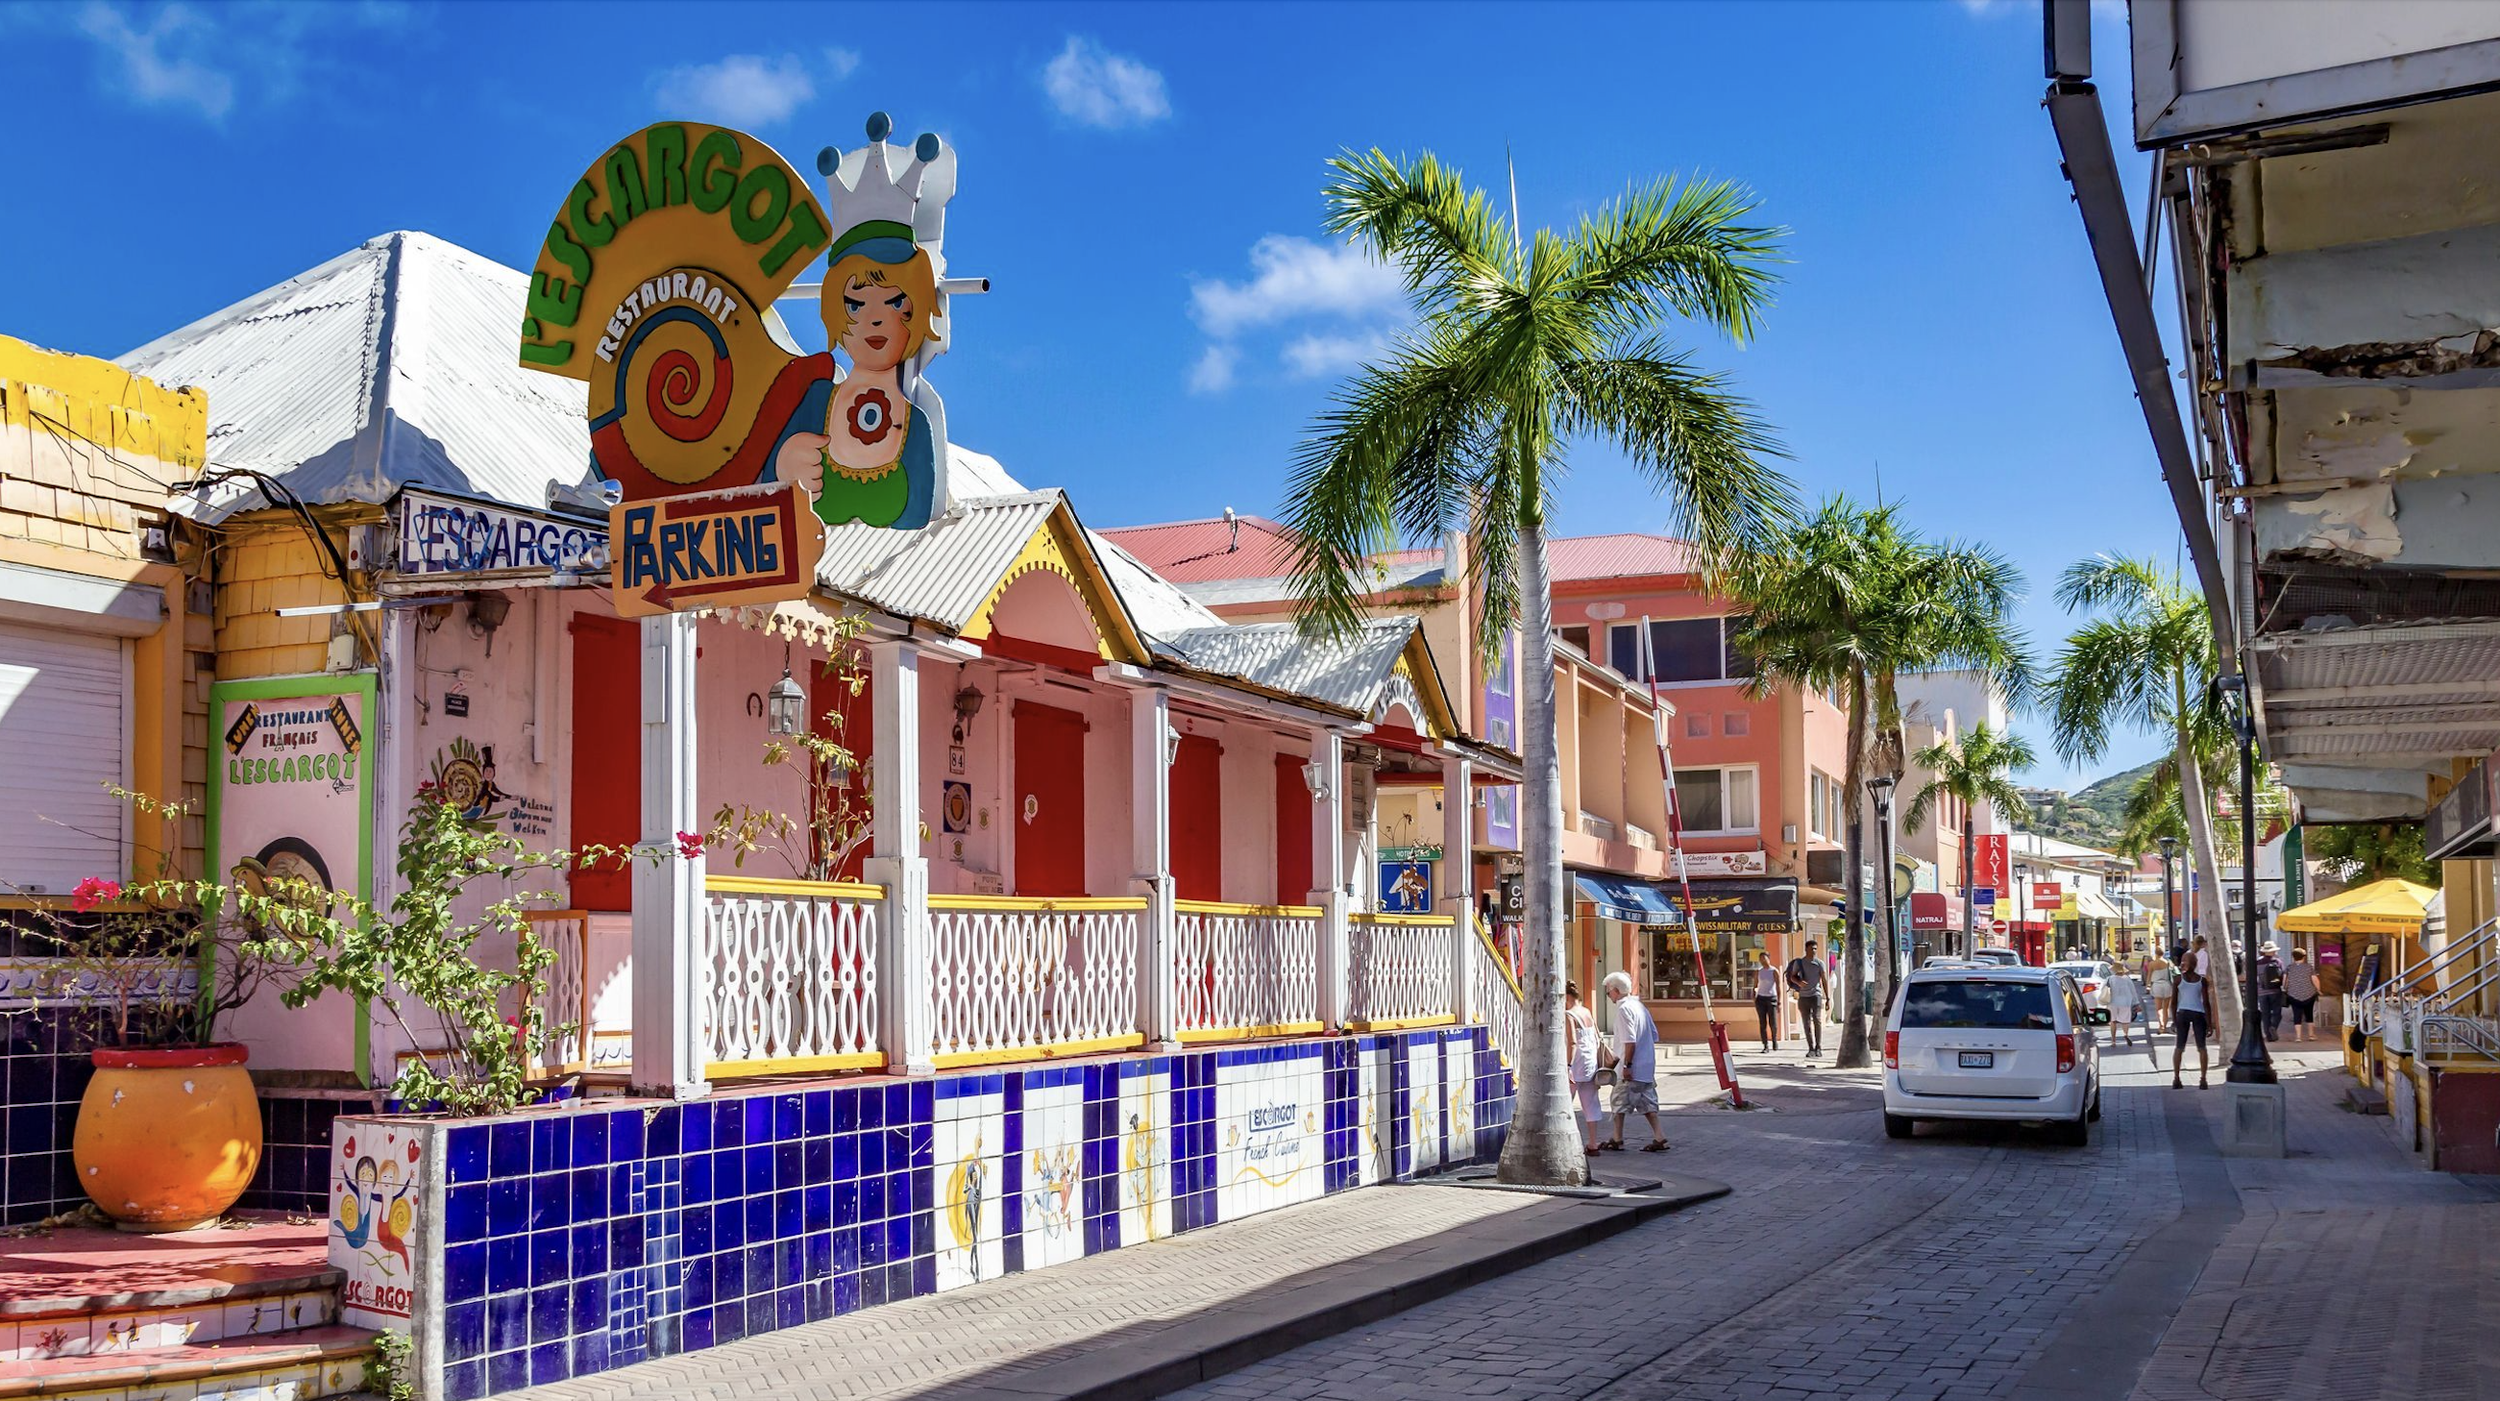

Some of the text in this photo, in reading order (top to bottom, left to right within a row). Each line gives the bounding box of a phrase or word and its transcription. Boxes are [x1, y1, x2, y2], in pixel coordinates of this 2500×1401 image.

[520, 124, 829, 366] L'ESCARGOT
[595, 272, 739, 363] RESTAURANT
[255, 708, 332, 728] RESTAURANT
[229, 752, 357, 785] L'ESCARGOT
[951, 752, 963, 768] 84
[1989, 836, 2001, 886] RAYS
[1717, 922, 1751, 931] MILITARY
[1758, 922, 1786, 931] GUESS
